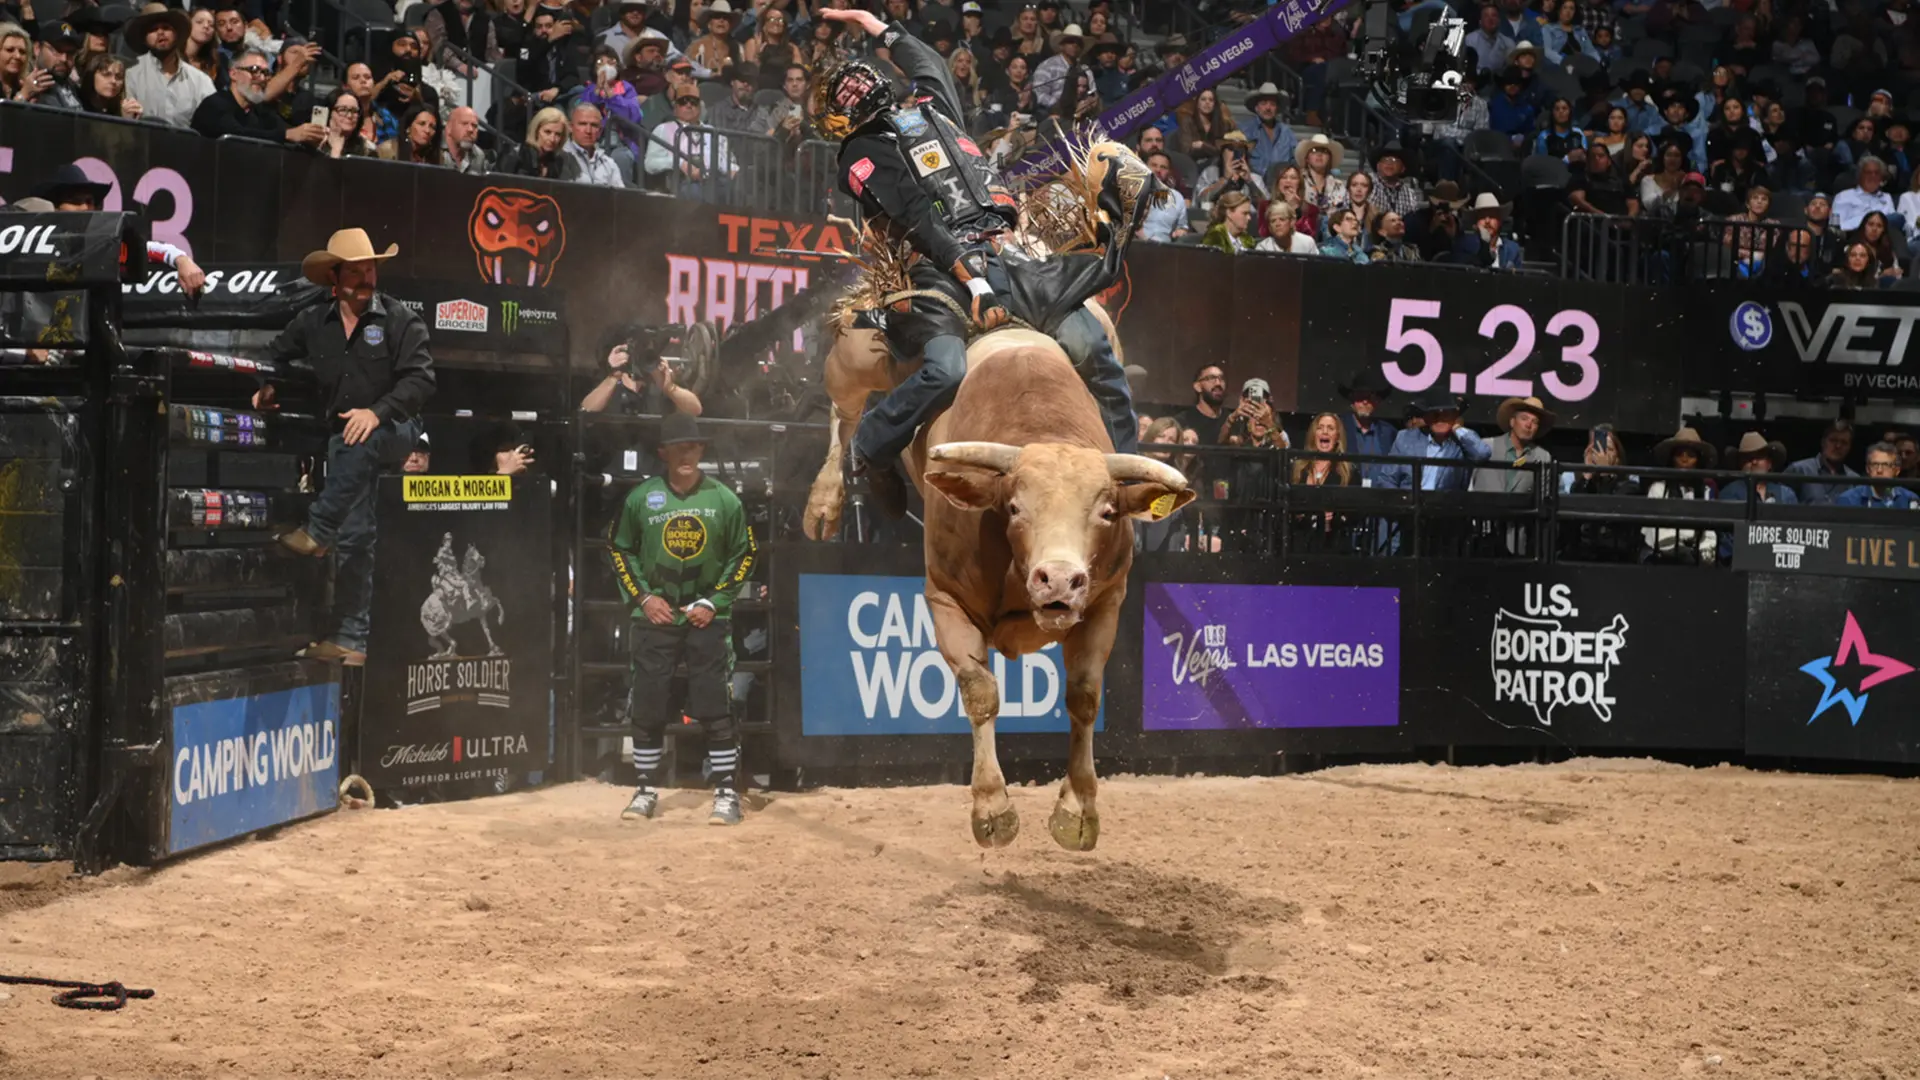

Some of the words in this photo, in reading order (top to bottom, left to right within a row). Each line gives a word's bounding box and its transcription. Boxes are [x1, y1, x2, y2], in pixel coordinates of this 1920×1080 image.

[1200, 57, 1221, 75] LAS
[1218, 37, 1254, 63] VEGAS
[1108, 113, 1128, 130] LAS
[1124, 97, 1156, 120] VEGAS
[912, 142, 939, 157] ARIAT
[718, 213, 855, 263] TEXA
[121, 270, 223, 294] UCS
[439, 301, 485, 321] SUPERIOR
[519, 308, 557, 320] MONSTER
[438, 320, 485, 329] GROCERS
[1381, 298, 1600, 402] 5.23
[1844, 373, 1863, 387] BY
[1866, 374, 1920, 389] VECHA
[409, 480, 451, 497] MORGAN
[453, 480, 461, 497] &
[463, 480, 506, 496] MORGAN
[648, 508, 701, 525] PROTECTED
[704, 508, 717, 517] BY
[666, 530, 702, 540] BORDER
[1748, 525, 1782, 545] HORSE
[1786, 528, 1830, 549] SOLDIER
[1775, 553, 1800, 569] CLUB
[1846, 537, 1897, 567] LIVE
[734, 555, 753, 581] SAFET
[1524, 582, 1579, 617] U.S.
[1206, 627, 1225, 644] LAS
[1495, 628, 1620, 665] BORDER
[1163, 628, 1237, 687] Vegas
[1247, 643, 1298, 668] LAS
[1302, 643, 1384, 668] VEGAS
[407, 664, 451, 698] HORSE
[457, 659, 510, 692] SOLDIER
[850, 650, 1060, 719] WOLD
[1495, 669, 1617, 705] PATROL
[174, 730, 269, 806] CAMPING
[270, 719, 336, 782] WORLD
[380, 742, 450, 768] Michelob
[466, 734, 528, 759] ULTRA
[402, 772, 450, 785] SUPERIOR
[455, 770, 482, 781] LIGHT
[486, 767, 508, 778] BEER
